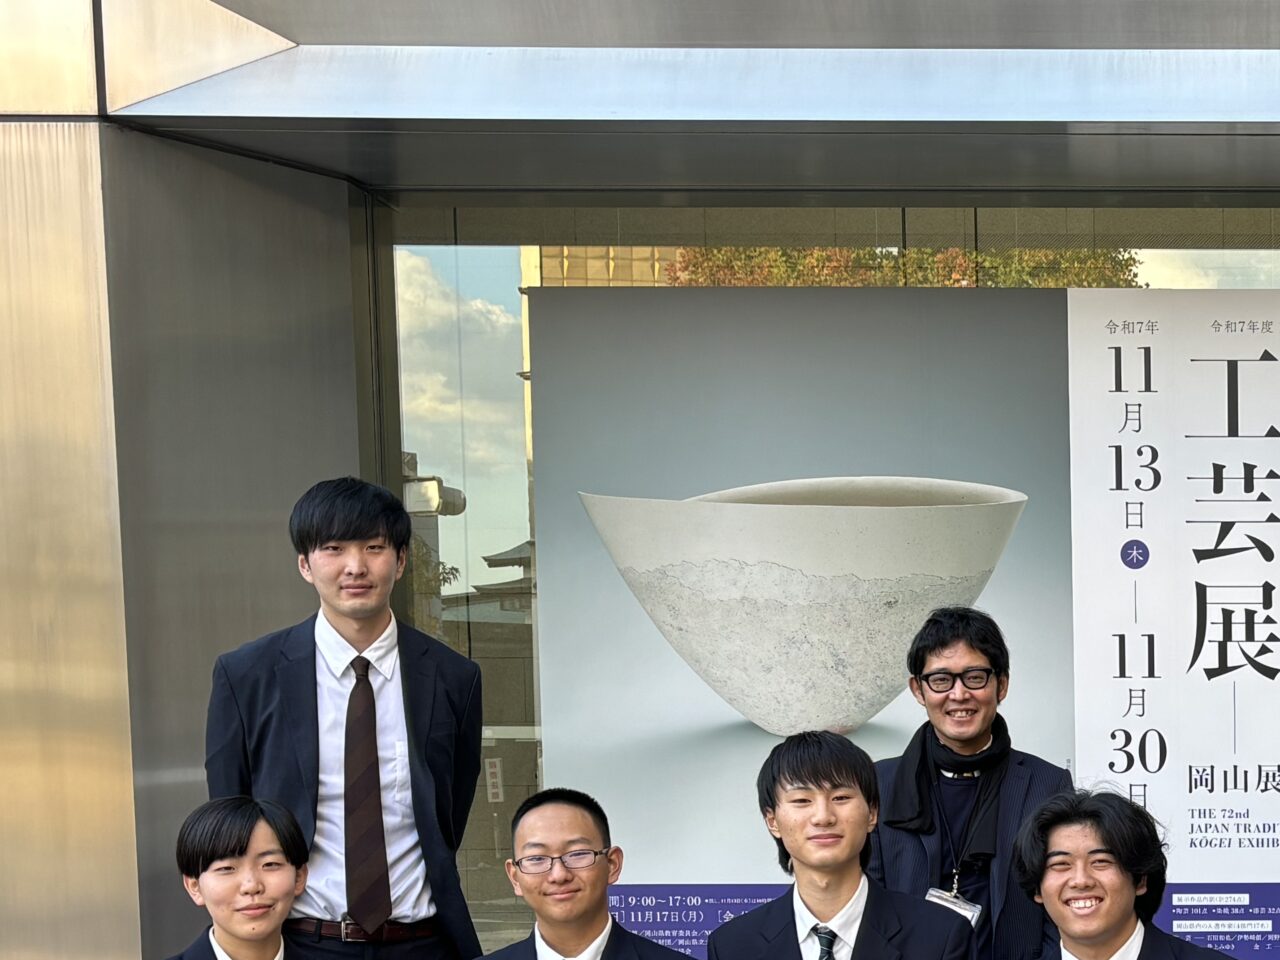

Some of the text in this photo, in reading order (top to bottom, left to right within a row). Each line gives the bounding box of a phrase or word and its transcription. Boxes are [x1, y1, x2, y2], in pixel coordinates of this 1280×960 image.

[1105, 319, 1160, 335] 令和7年
[1210, 319, 1274, 334] 令和7年度
[1187, 808, 1250, 820] THE 72nd
[1188, 822, 1230, 835] JAPAN
